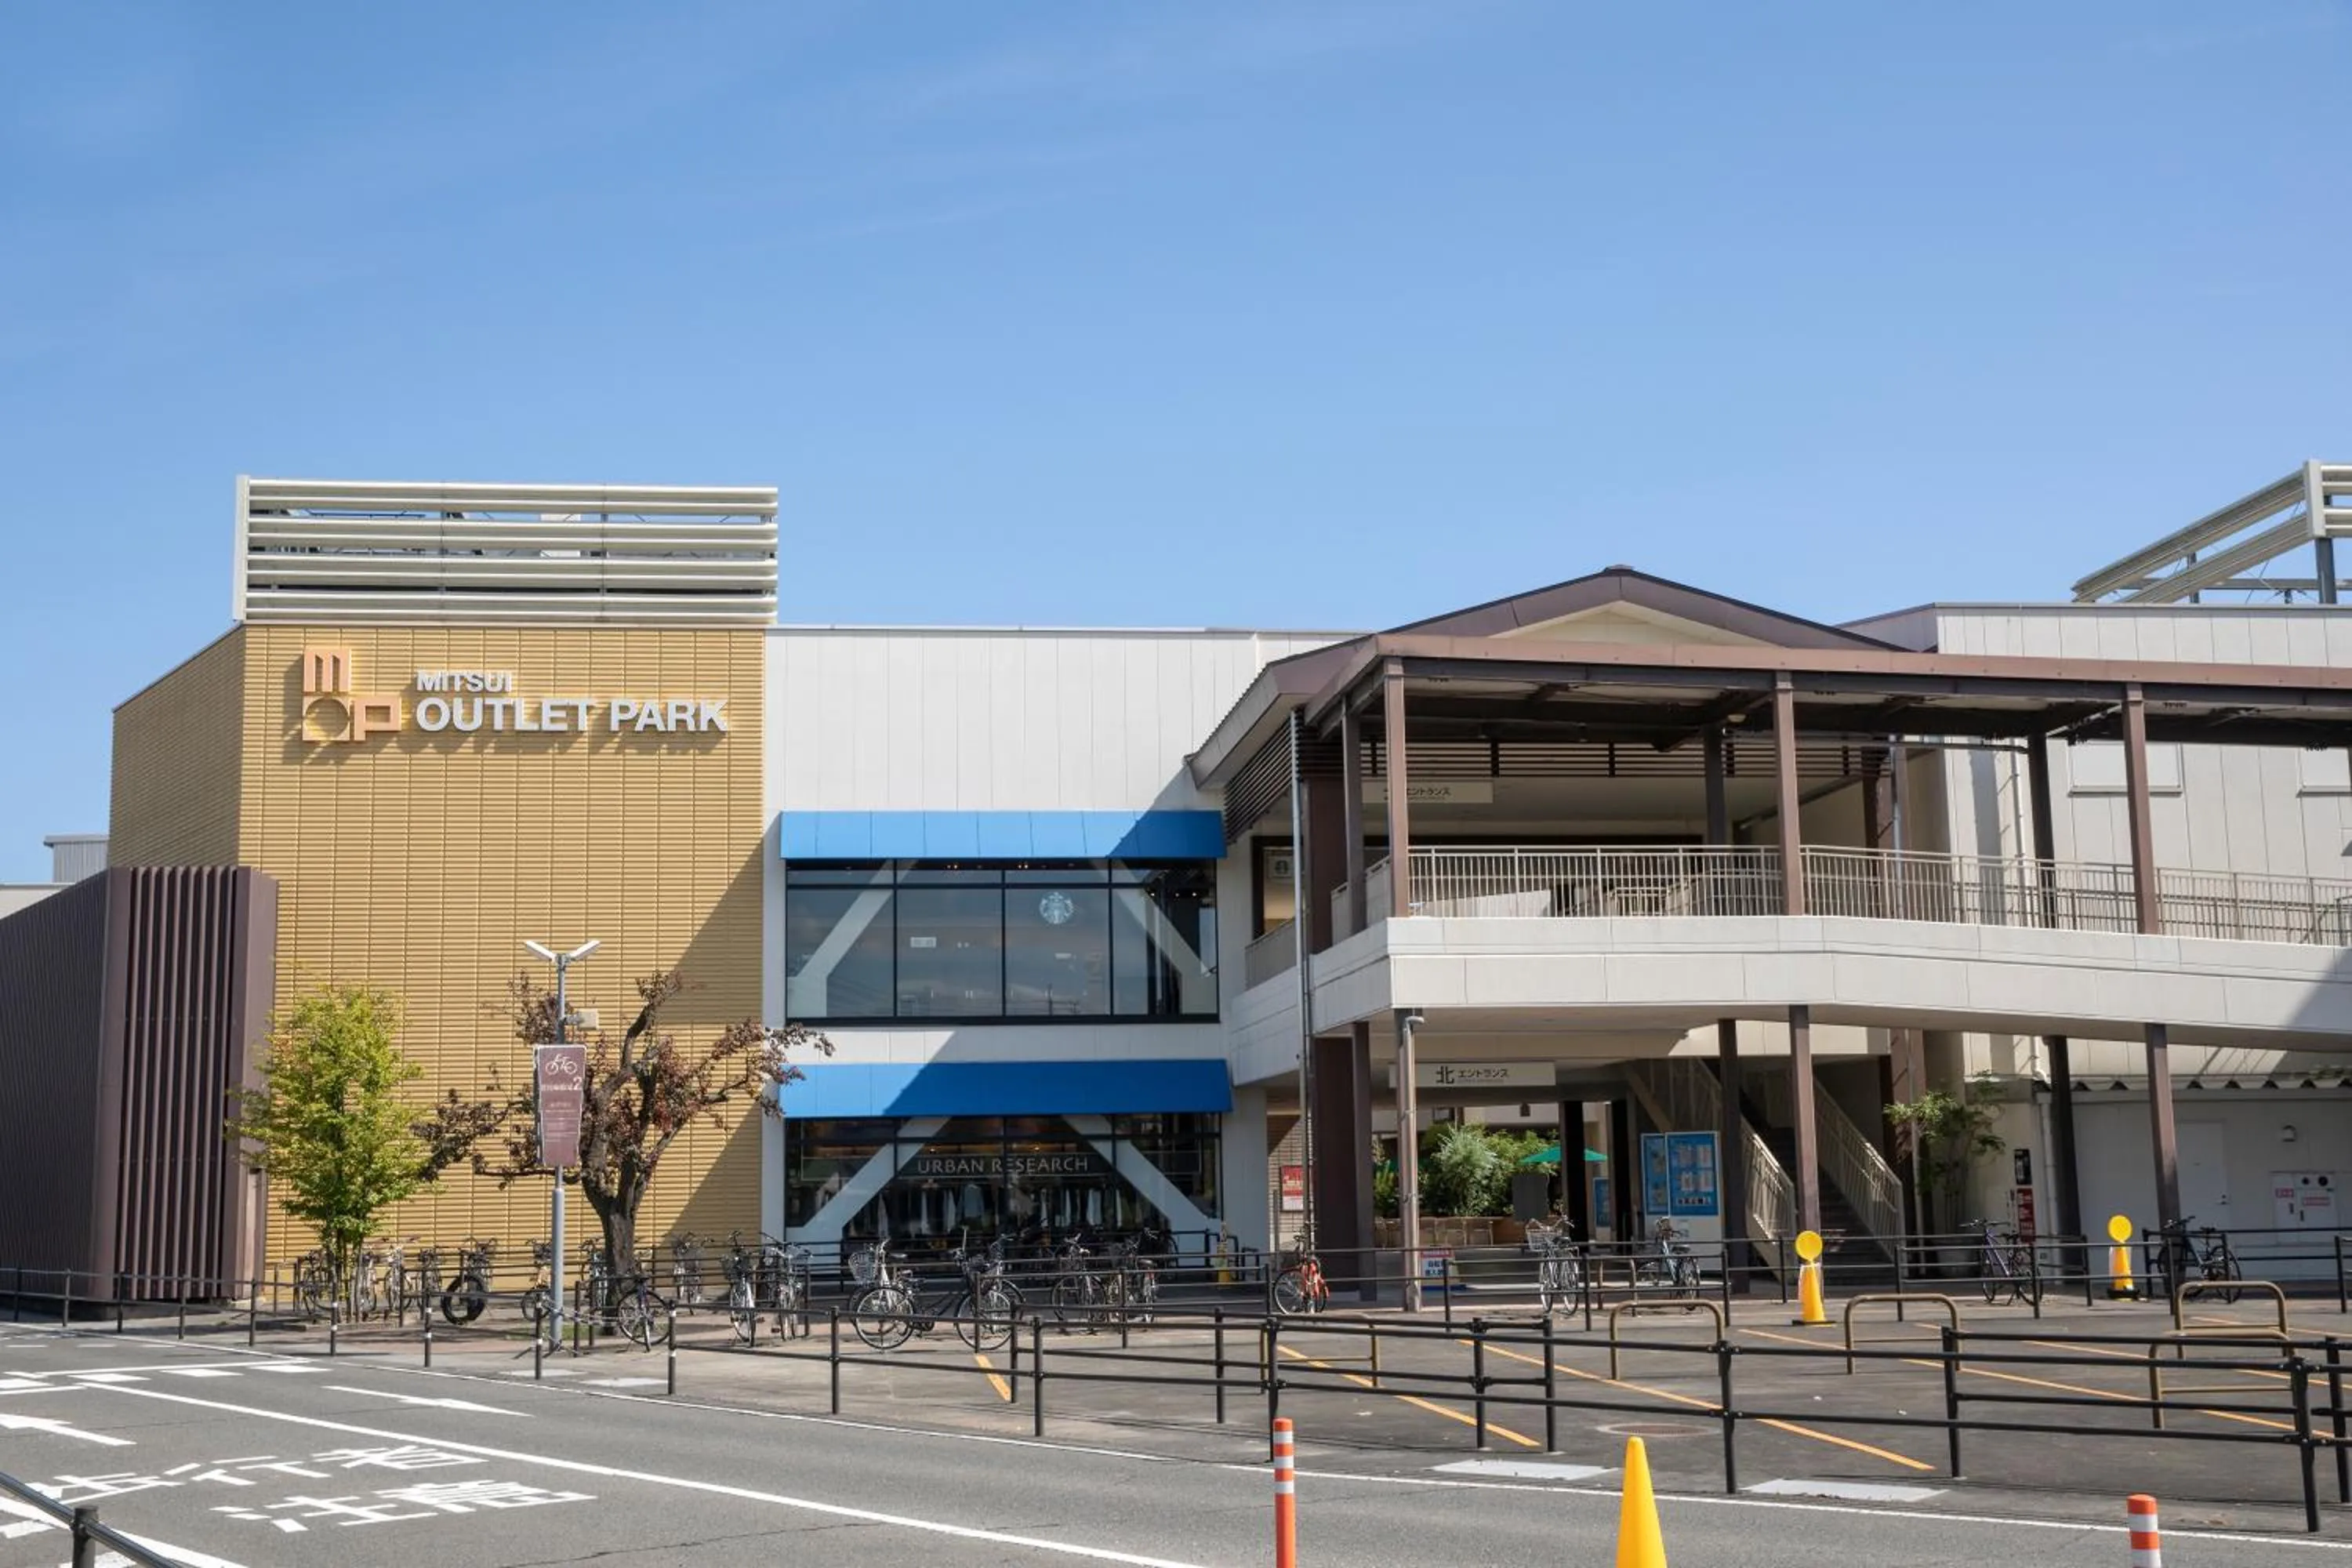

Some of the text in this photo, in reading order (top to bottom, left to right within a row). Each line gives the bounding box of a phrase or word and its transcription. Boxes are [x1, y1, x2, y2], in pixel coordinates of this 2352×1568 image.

[416, 670, 512, 692] MITSUI
[416, 697, 729, 732] OUTLET PARK
[917, 1157, 1088, 1174] URBAN RESEARCH
[209, 1480, 598, 1534] 注意
